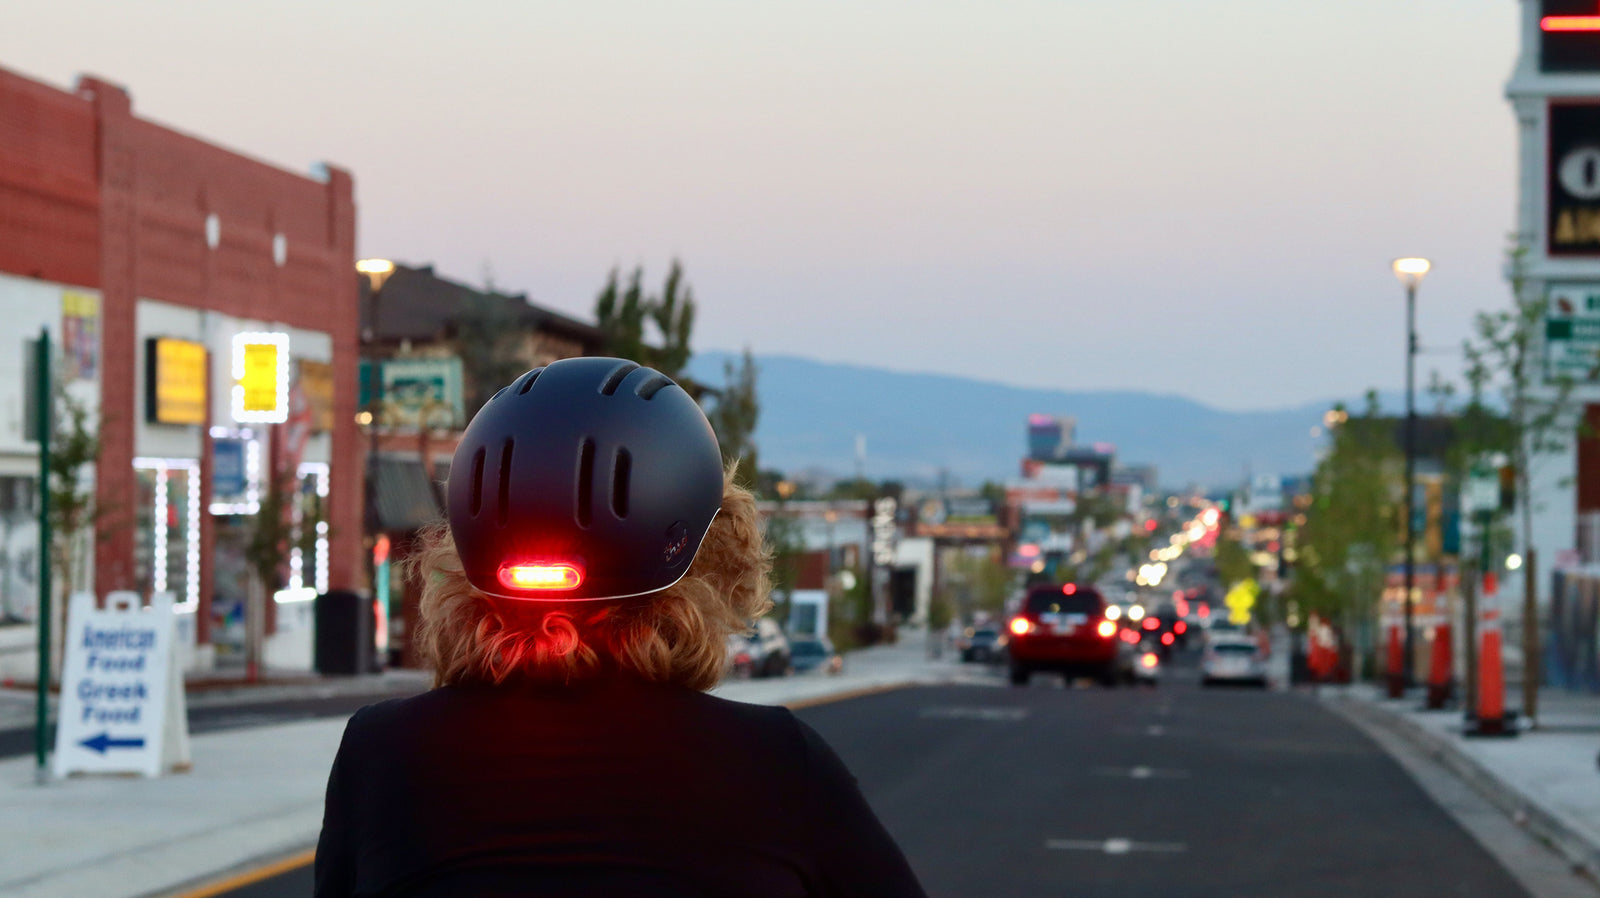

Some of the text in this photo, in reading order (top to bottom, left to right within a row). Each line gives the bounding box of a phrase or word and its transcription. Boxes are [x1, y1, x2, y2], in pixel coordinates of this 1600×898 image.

[82, 626, 156, 650] American
[86, 654, 147, 672] Food
[78, 679, 149, 700] Greek
[82, 704, 140, 723] Food
